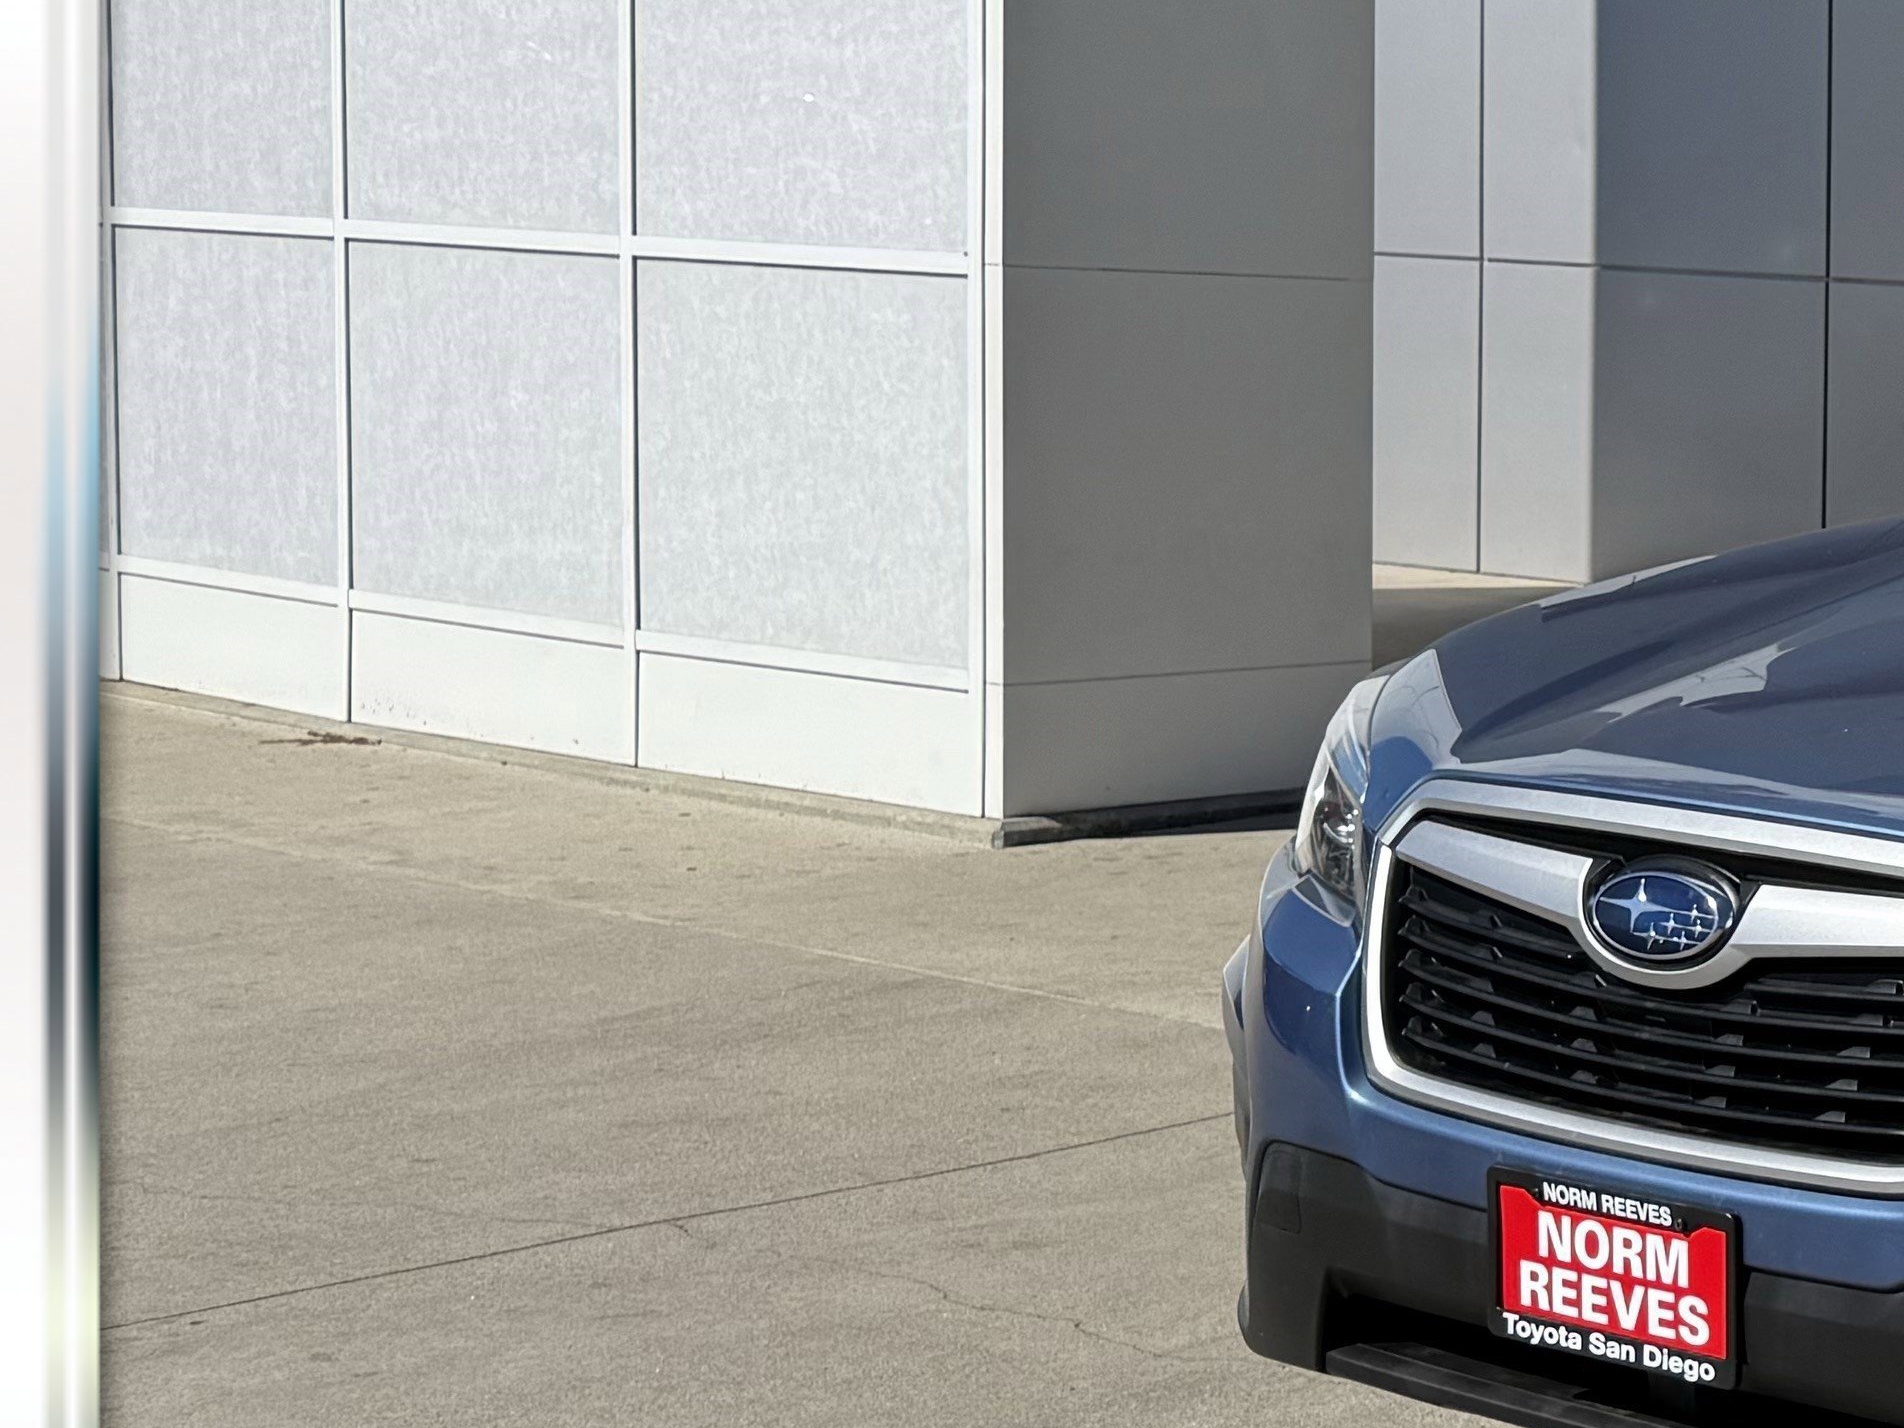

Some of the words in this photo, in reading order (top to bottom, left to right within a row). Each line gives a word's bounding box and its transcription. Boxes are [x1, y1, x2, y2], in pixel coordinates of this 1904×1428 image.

[1542, 1181, 1597, 1211] NORM
[1601, 1193, 1673, 1227] REEVES
[1537, 1209, 1690, 1288] NORM
[1519, 1259, 1710, 1346] REEVES
[1502, 1311, 1583, 1351] Toyota
[1588, 1332, 1636, 1363] San
[1643, 1344, 1716, 1383] Diego
